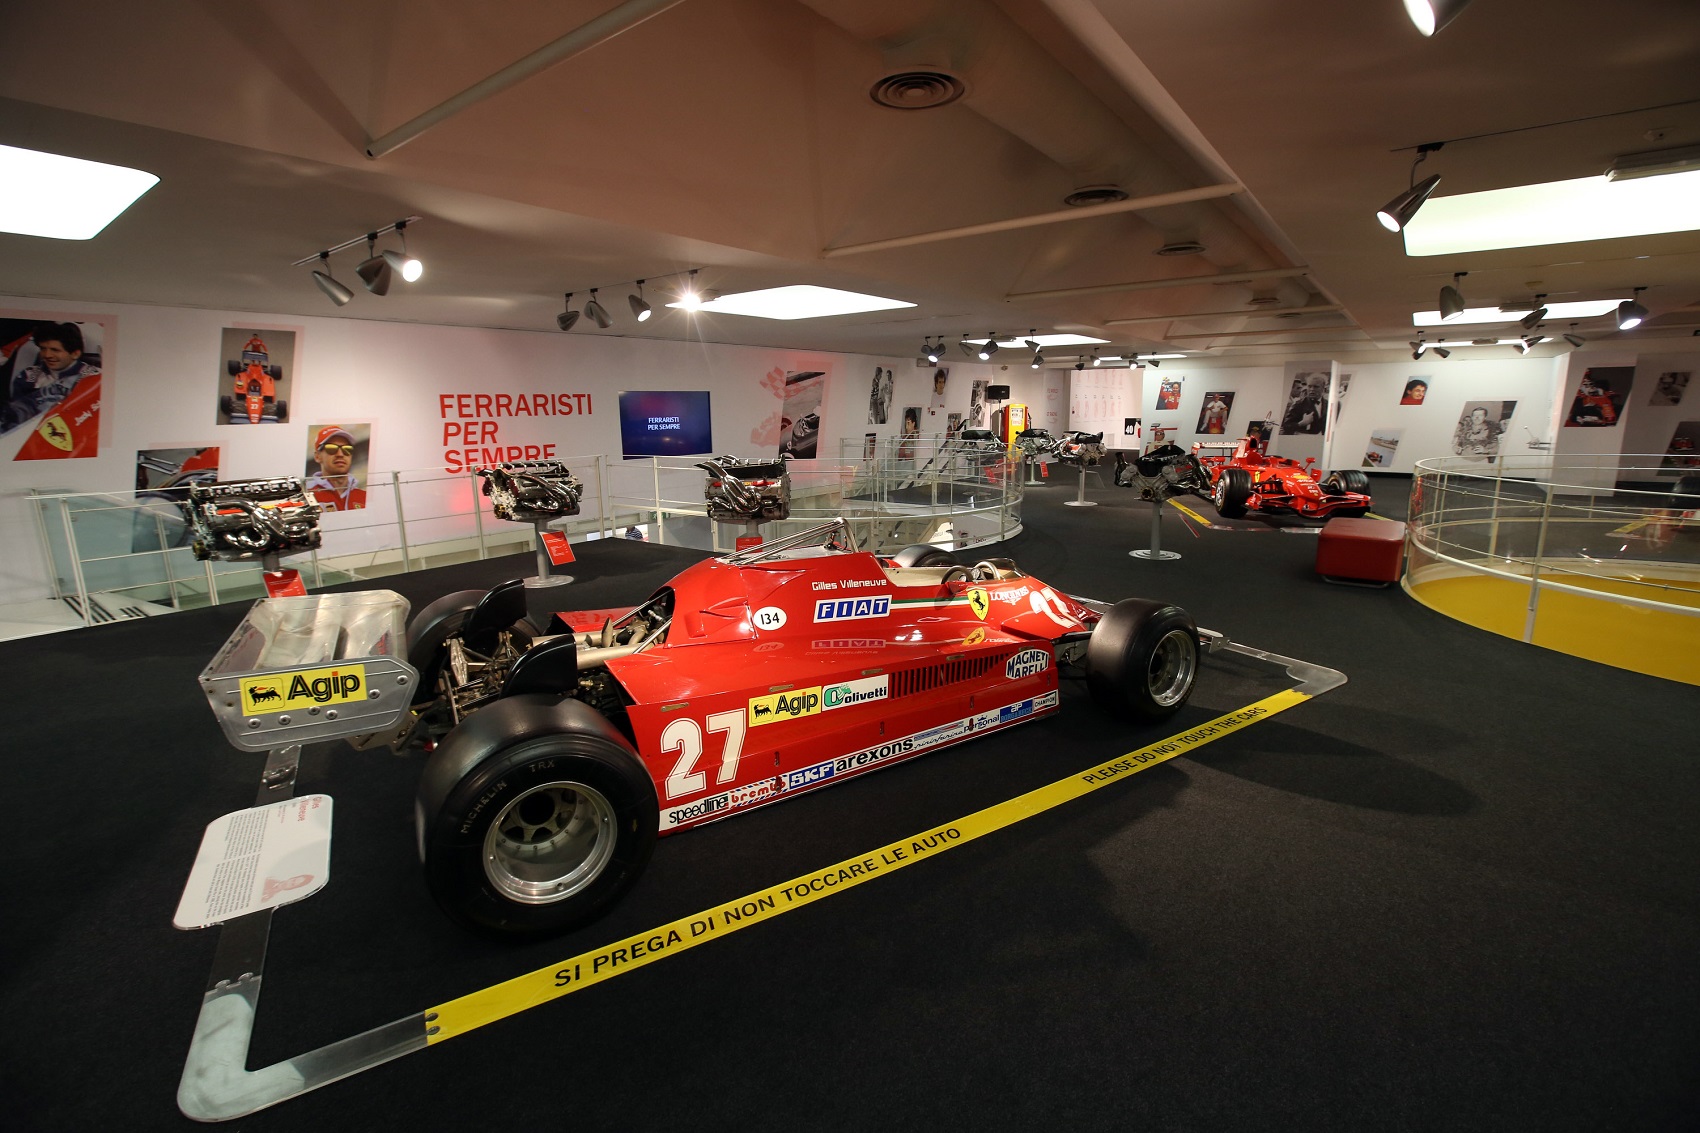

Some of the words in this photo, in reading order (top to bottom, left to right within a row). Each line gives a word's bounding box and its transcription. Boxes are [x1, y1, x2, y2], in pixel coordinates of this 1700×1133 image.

[439, 394, 593, 418] FERRARISTI
[648, 416, 680, 424] FERRARISTI
[1125, 425, 1134, 434] 40
[443, 421, 499, 446] PER
[811, 581, 838, 591] Gilles
[839, 578, 888, 589] Villeneuve
[760, 612, 780, 625] 134
[820, 599, 889, 618] FIAT
[1006, 650, 1049, 674] MAGNETI
[287, 671, 360, 703] Agip
[844, 687, 888, 704] olivetti
[775, 691, 819, 716] Agip
[1034, 696, 1056, 708] CHAMPION
[660, 708, 747, 800] 27
[835, 737, 914, 773] arexons
[1082, 760, 1138, 785] PLEASE
[1138, 752, 1156, 764] DO
[1155, 741, 1182, 756] NOT
[1179, 727, 1221, 746] TOUCH
[1215, 717, 1242, 732] THE
[1239, 706, 1269, 722] CARS
[528, 760, 555, 773] TRX
[791, 764, 833, 789] SKF
[461, 780, 508, 834] MICHELIN
[669, 796, 726, 824] speedline
[553, 964, 582, 988] SI
[591, 929, 683, 975] PREGA
[690, 914, 716, 937] DI
[723, 894, 777, 926] NON
[780, 858, 879, 903] TOCCARE
[880, 847, 909, 866] LE
[912, 827, 962, 854] AUTO
